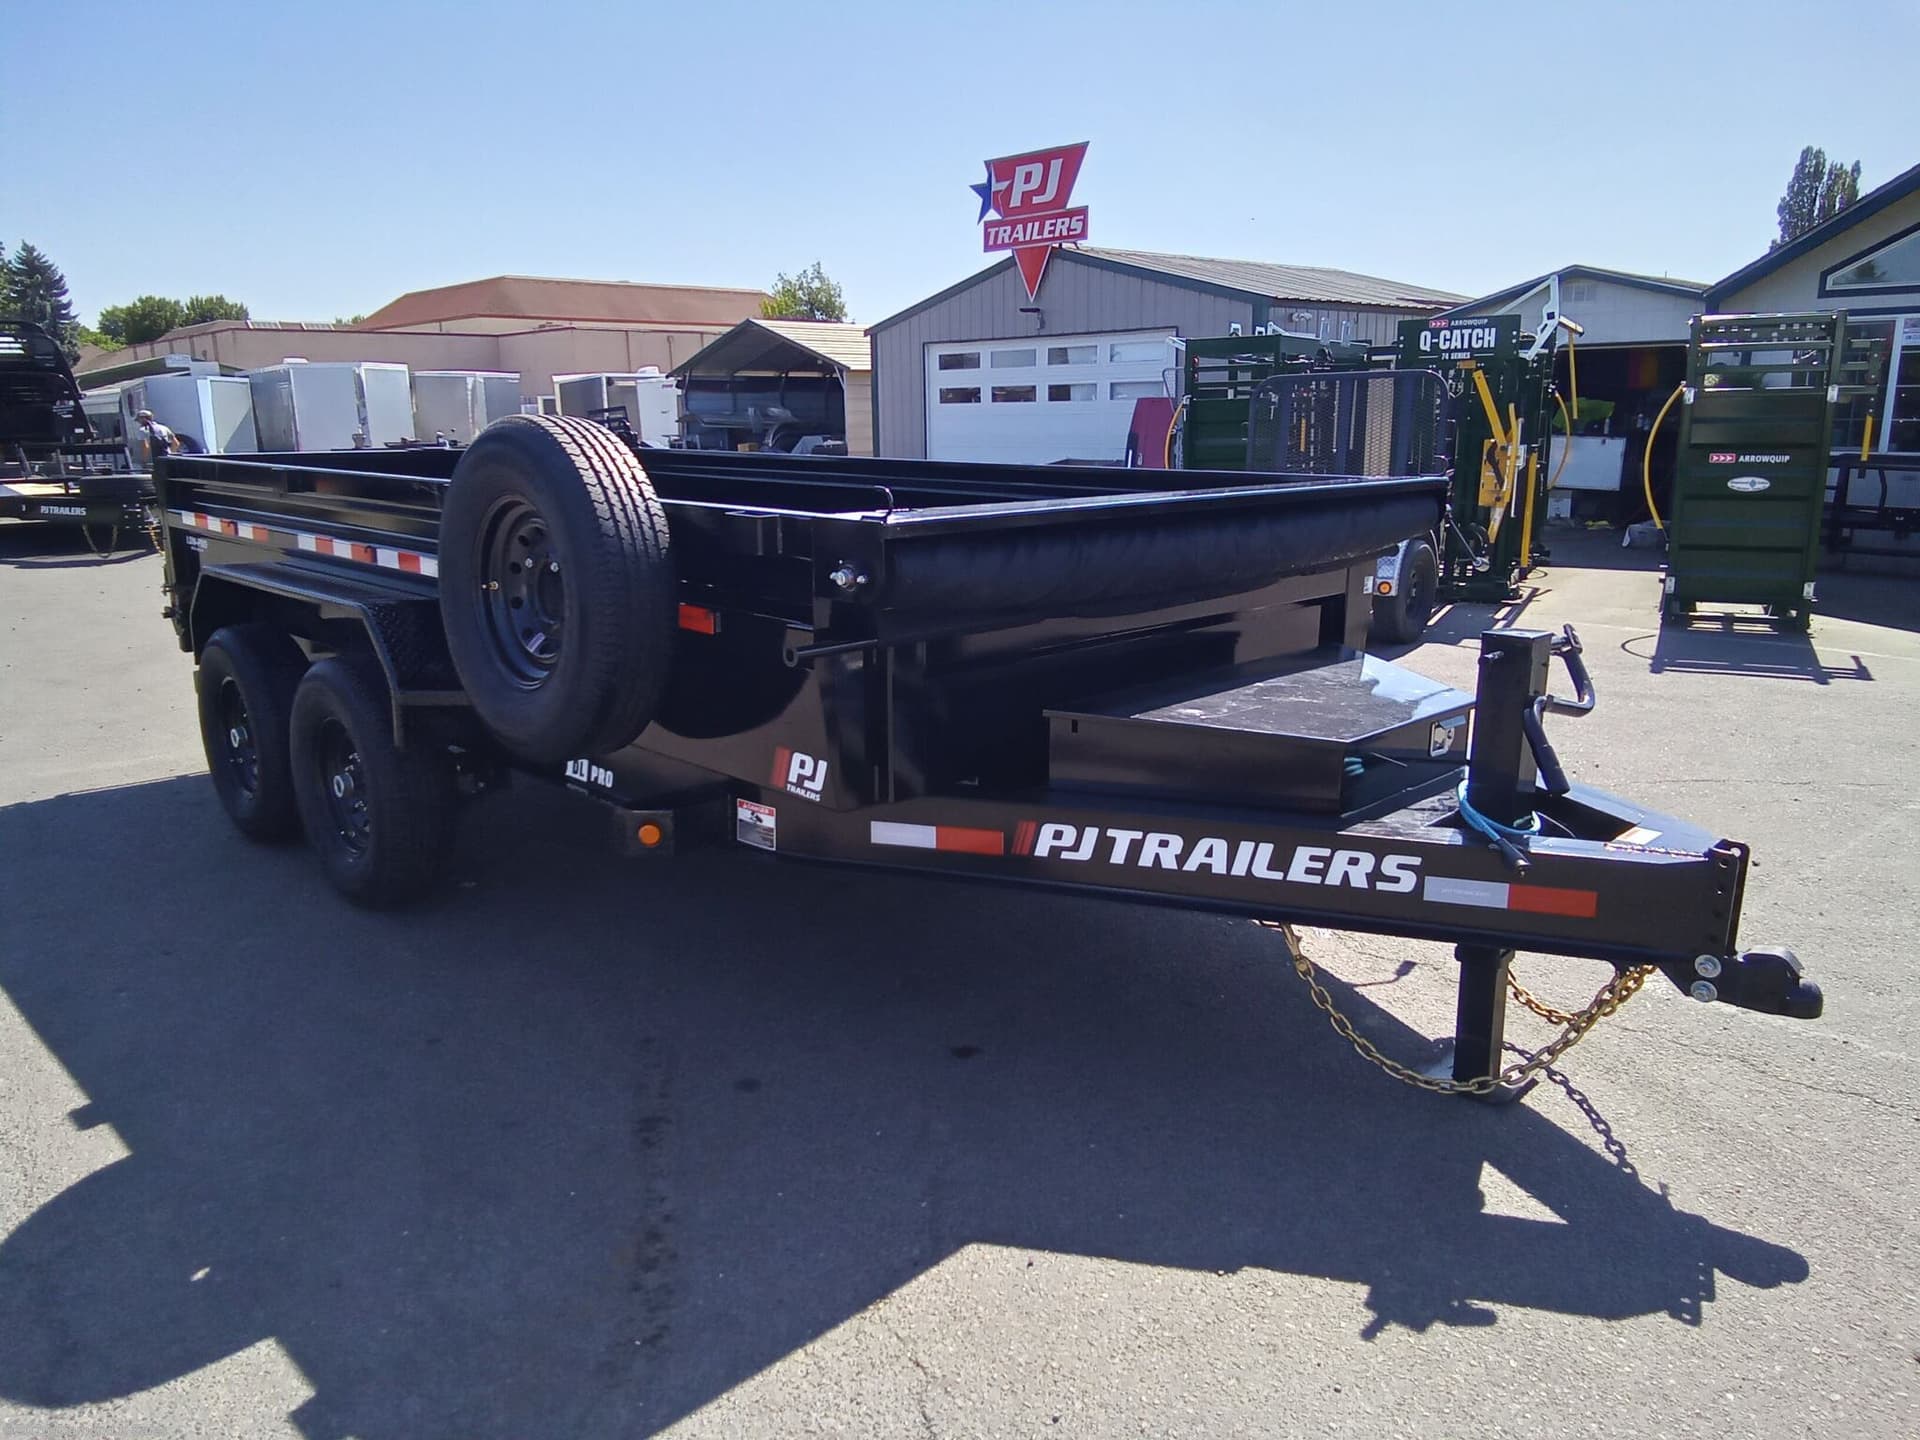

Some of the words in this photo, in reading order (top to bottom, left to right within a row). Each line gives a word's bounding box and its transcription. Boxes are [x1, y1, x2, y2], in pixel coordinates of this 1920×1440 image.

[1009, 158, 1064, 208] PJ
[987, 215, 1084, 246] TRAILERS
[1420, 327, 1496, 352] Q-CATCH
[1738, 455, 1790, 463] ARROWQUIP
[590, 765, 613, 788] PRO
[788, 752, 828, 791] PJ
[786, 783, 821, 802] TRAILERS
[1034, 823, 1100, 861] PJ
[1106, 829, 1423, 893] TRAILERS
